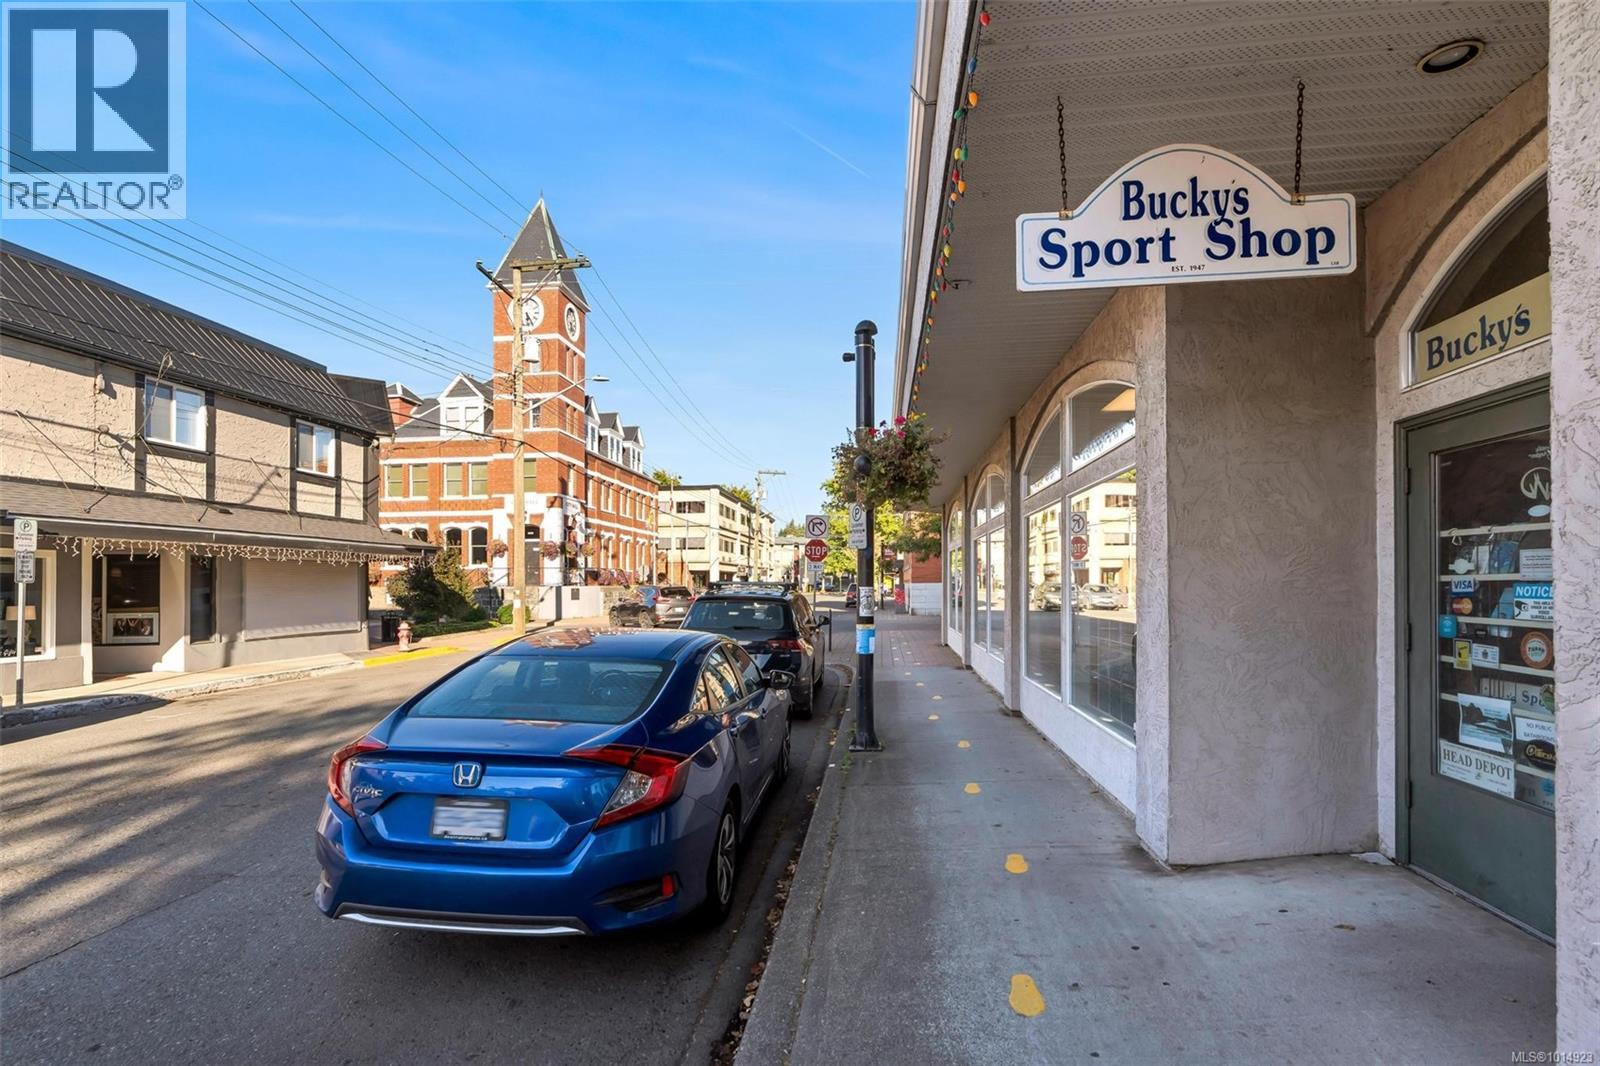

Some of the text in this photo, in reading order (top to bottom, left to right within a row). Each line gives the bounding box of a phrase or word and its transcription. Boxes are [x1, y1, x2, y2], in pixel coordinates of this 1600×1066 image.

[1121, 176, 1249, 226] Bucky's
[1038, 217, 1336, 278] Sport Shop
[1190, 264, 1206, 272] 1947
[1427, 304, 1531, 371] Bucky's
[806, 546, 827, 555] STOP
[1453, 580, 1473, 590] VISA
[1442, 748, 1473, 768] HEAD
[1475, 757, 1513, 780] DEPOT
